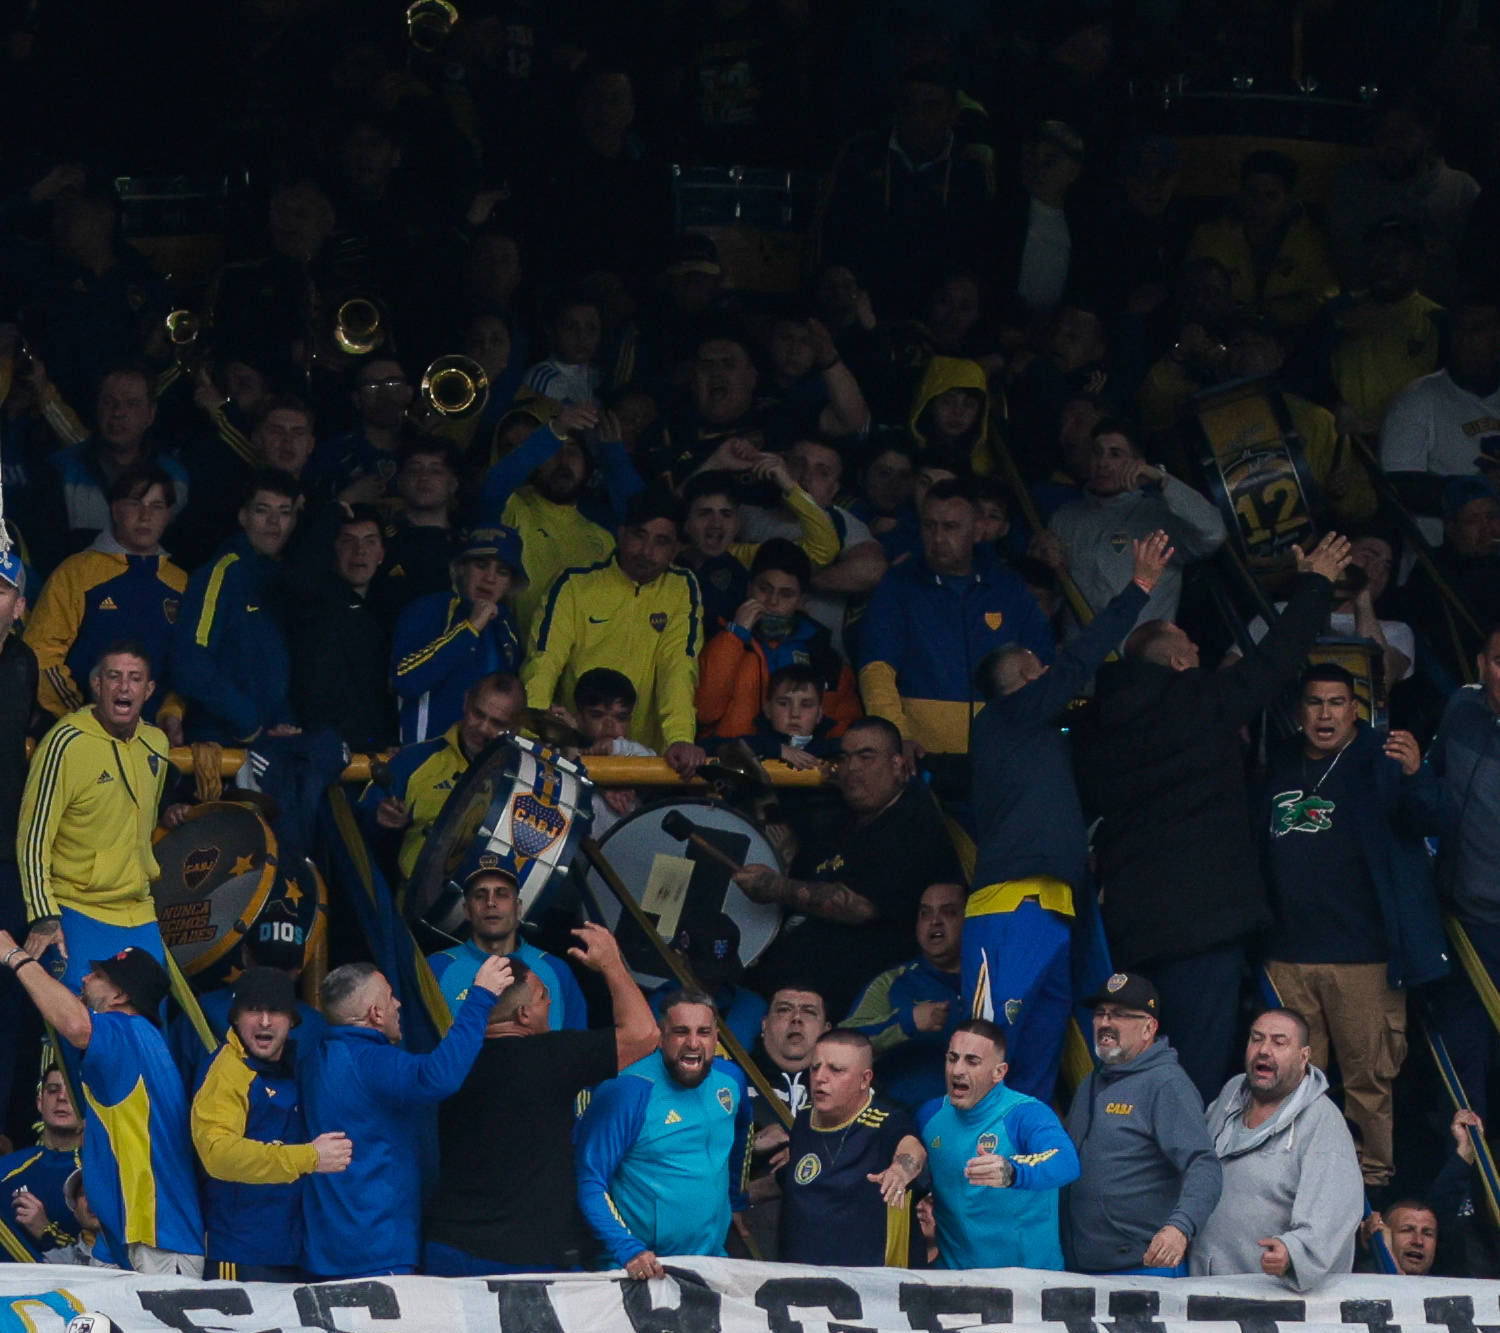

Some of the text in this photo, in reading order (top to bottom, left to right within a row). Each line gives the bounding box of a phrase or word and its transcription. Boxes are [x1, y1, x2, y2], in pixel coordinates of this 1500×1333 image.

[1236, 478, 1309, 544] 12
[515, 808, 557, 838] CABJ
[257, 920, 303, 945] D10S
